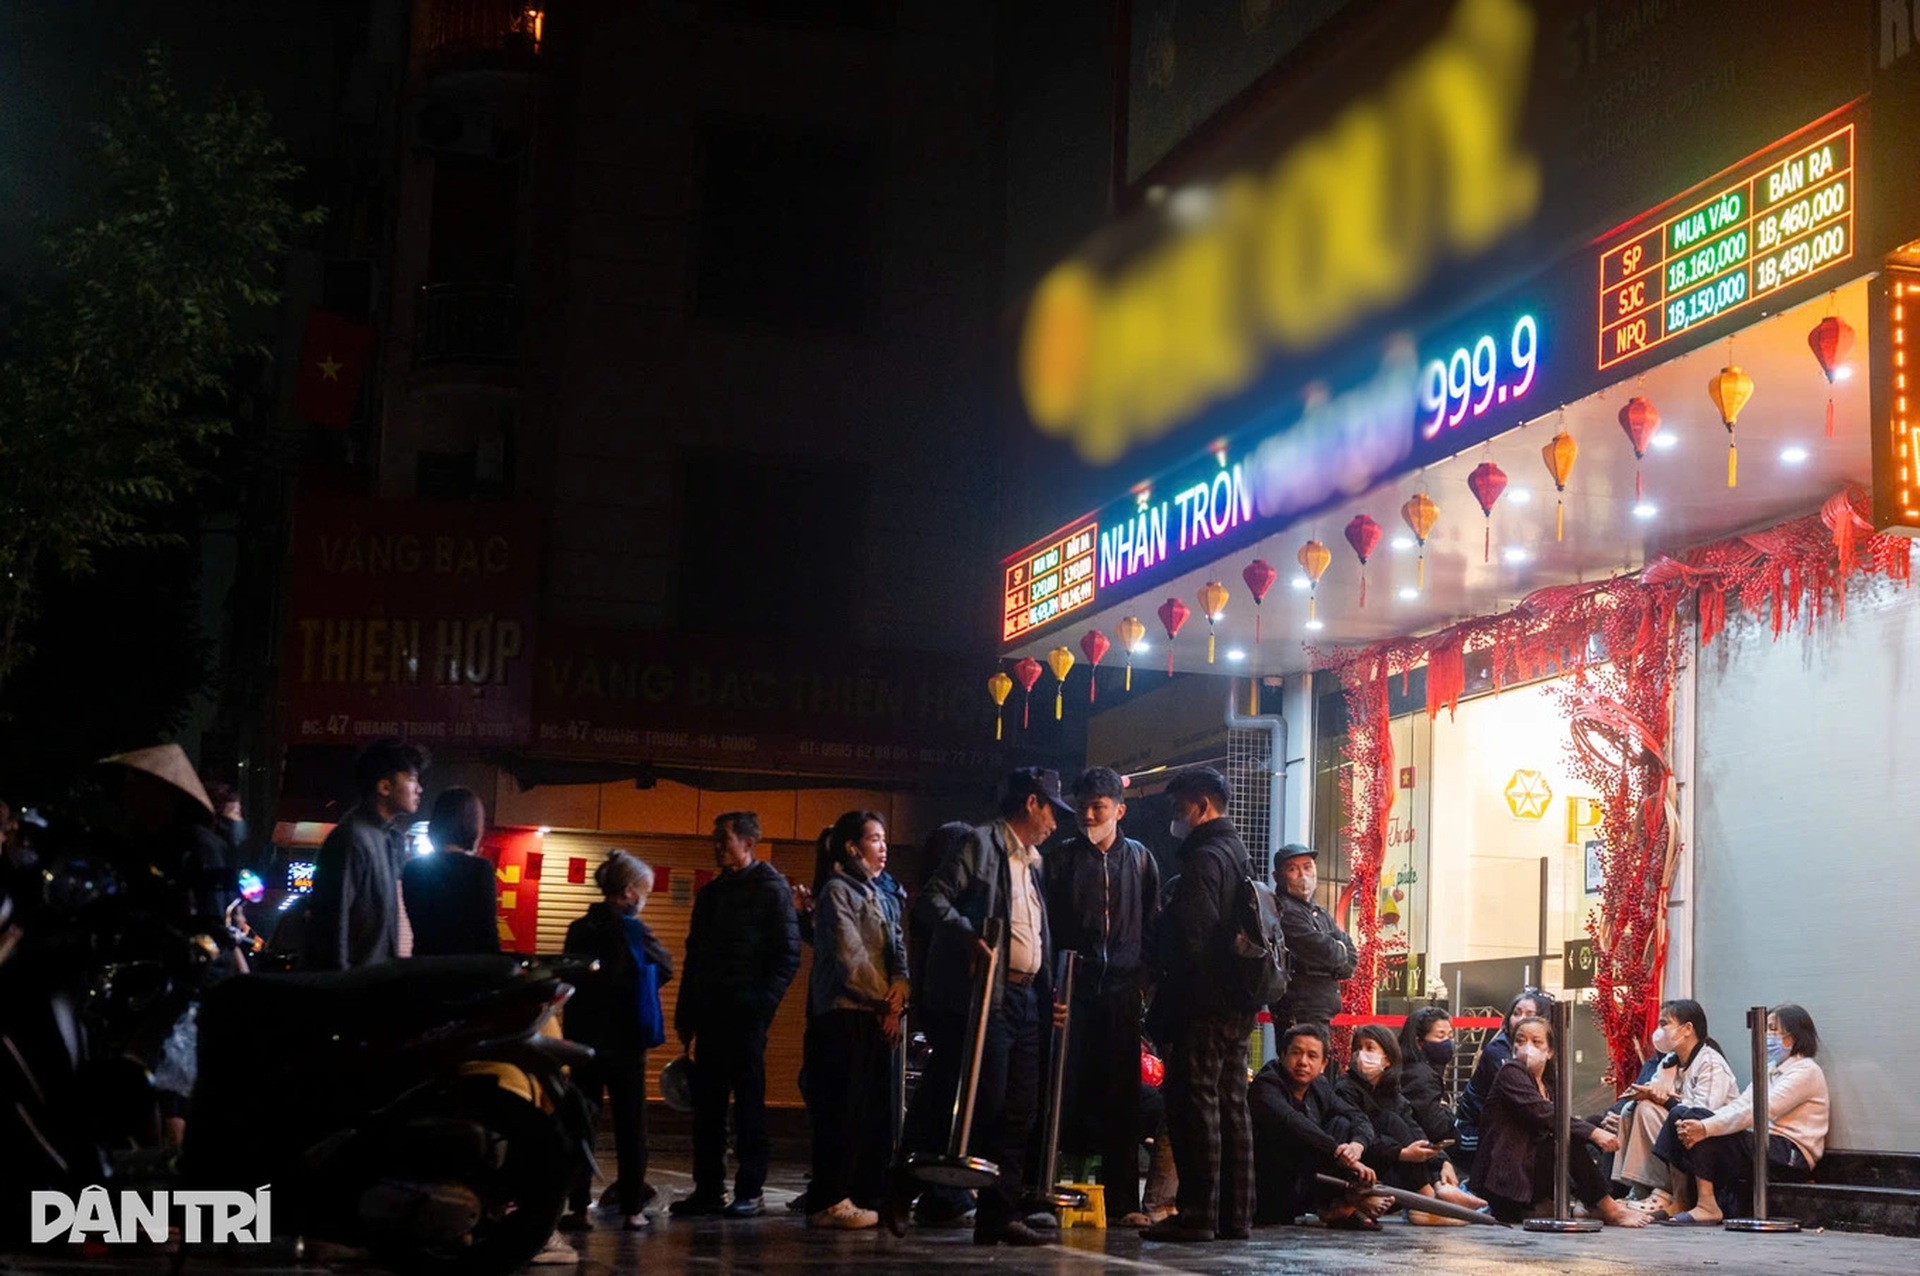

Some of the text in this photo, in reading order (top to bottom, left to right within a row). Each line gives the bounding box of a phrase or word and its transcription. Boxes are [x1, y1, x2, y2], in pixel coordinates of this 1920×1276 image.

[1769, 146, 1833, 203] BÁN RA
[1622, 246, 1642, 276] SP
[1757, 183, 1845, 250] 18,460,000
[1674, 194, 1740, 250] MUA VÀO
[1618, 226, 1845, 331] SJC 18,150,000 18,450,000
[1616, 322, 1646, 354] NPQ
[1175, 452, 1251, 551] TRÒN
[1421, 314, 1537, 440] 999.9
[318, 518, 511, 584] VÀNG BẠC
[296, 602, 522, 696] THIỆN HỢP
[326, 715, 350, 735] 47
[354, 720, 398, 736] QUANG
[567, 719, 592, 741] 47
